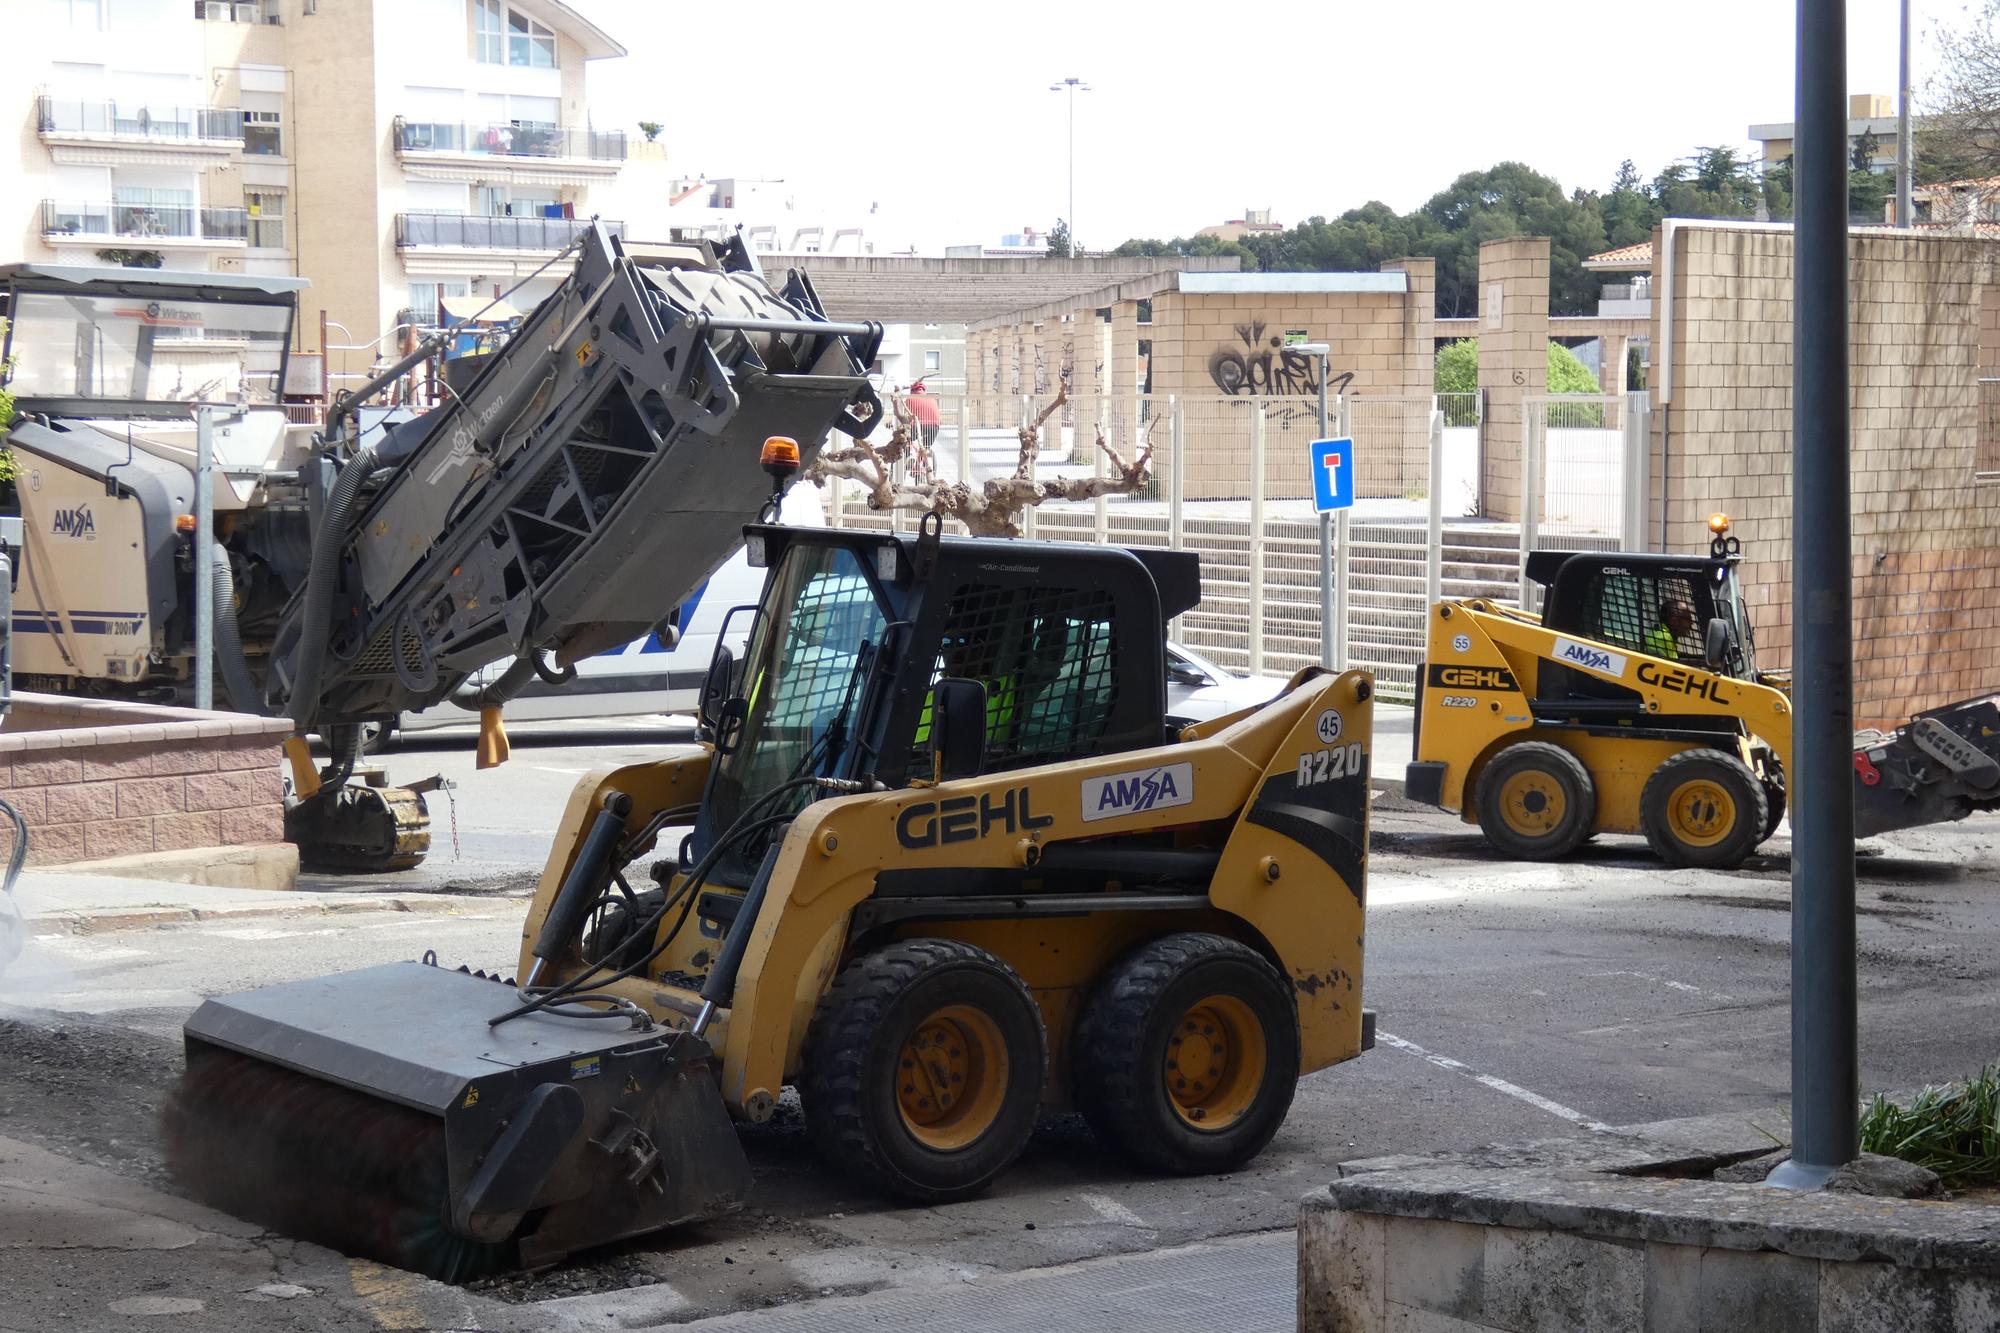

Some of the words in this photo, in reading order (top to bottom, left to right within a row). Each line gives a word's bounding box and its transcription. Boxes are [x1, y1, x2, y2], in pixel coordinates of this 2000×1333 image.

[162, 306, 203, 321] Wirtgen
[1602, 566, 1631, 576] GEHL
[1454, 637, 1470, 650] 55
[1564, 644, 1611, 669] AMSA
[1441, 668, 1510, 688] GEHL
[1637, 662, 1730, 705] GEHL
[1441, 695, 1478, 708] R220
[1320, 716, 1338, 736] 45
[1297, 741, 1363, 788] R220
[1098, 767, 1178, 811] AMSA
[896, 786, 1054, 849] GEHL
